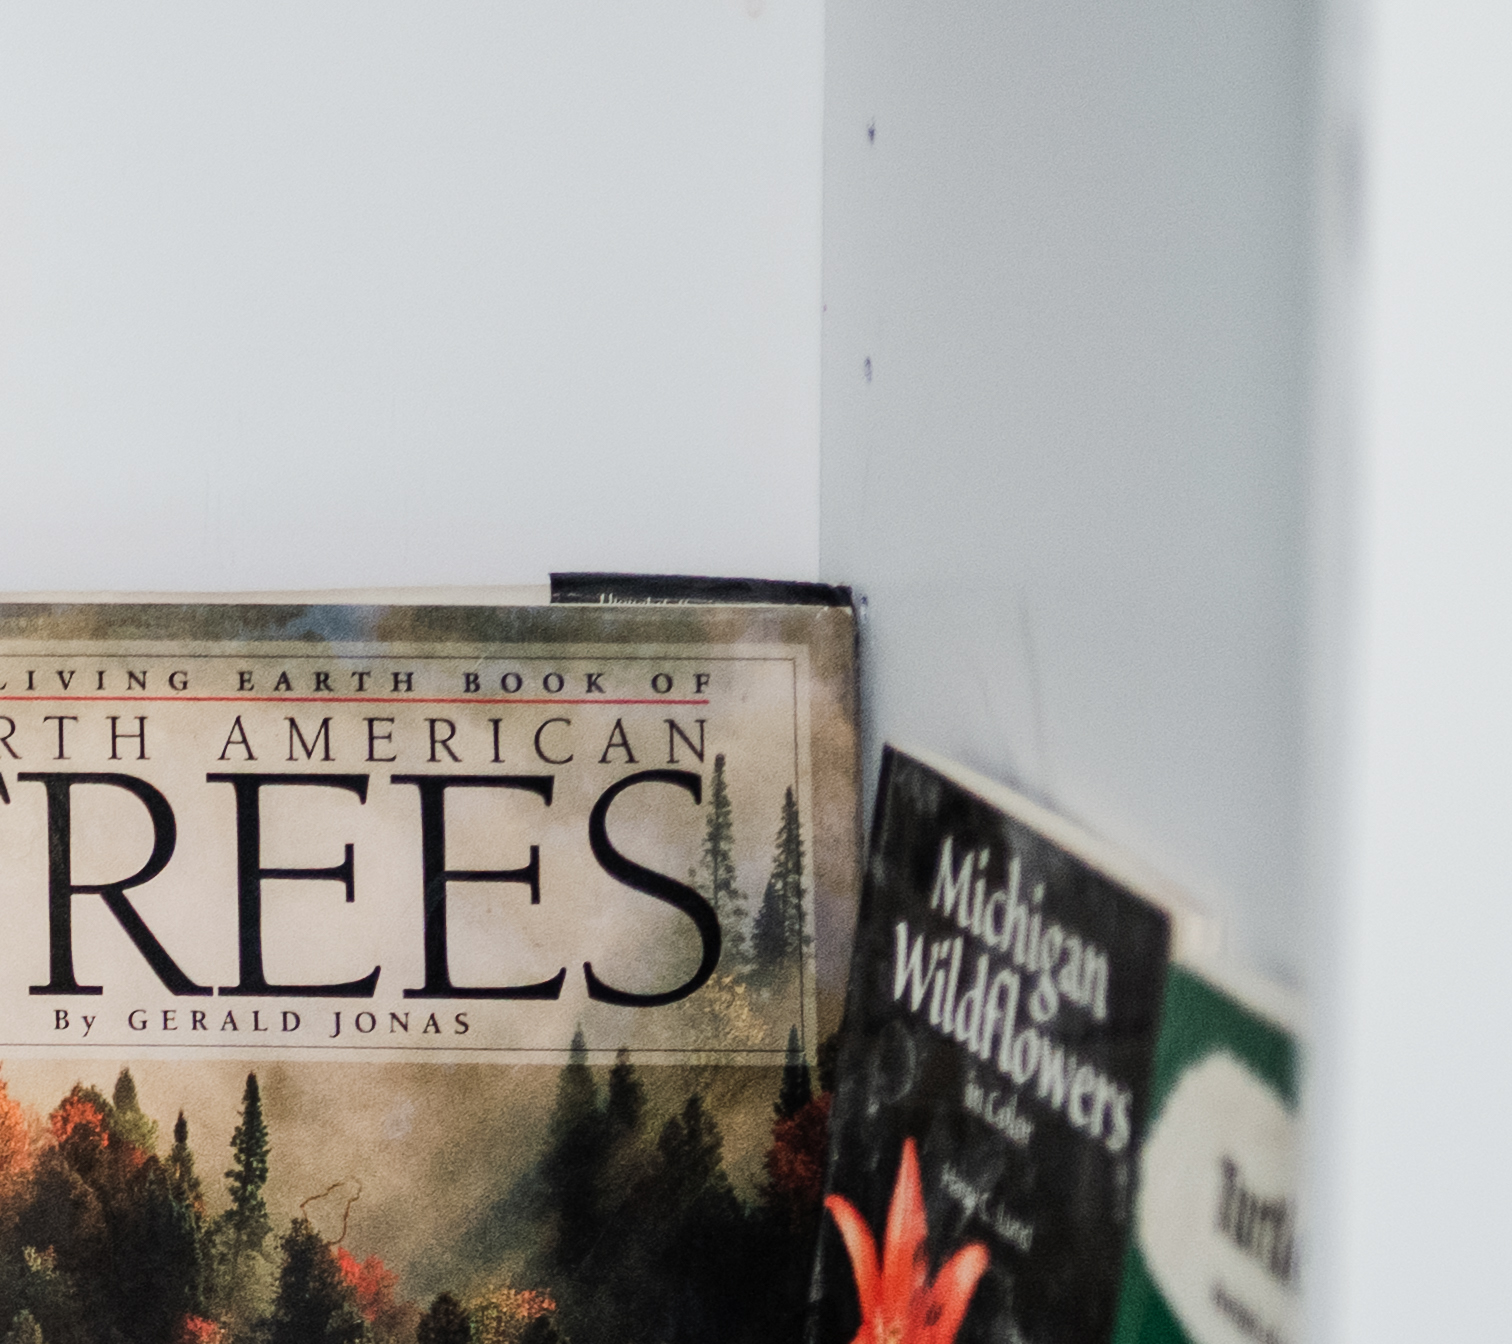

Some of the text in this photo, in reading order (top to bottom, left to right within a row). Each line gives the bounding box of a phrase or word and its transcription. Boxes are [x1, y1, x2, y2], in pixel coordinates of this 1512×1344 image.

[237, 670, 415, 695] EARTH
[463, 670, 607, 696] BOOK
[653, 671, 712, 696] OF
[217, 716, 712, 765] AMERICAN
[930, 835, 1110, 1025] Michigan
[53, 1009, 472, 1039] By GERALD JONAS
[893, 921, 1132, 1151] Wildflowers
